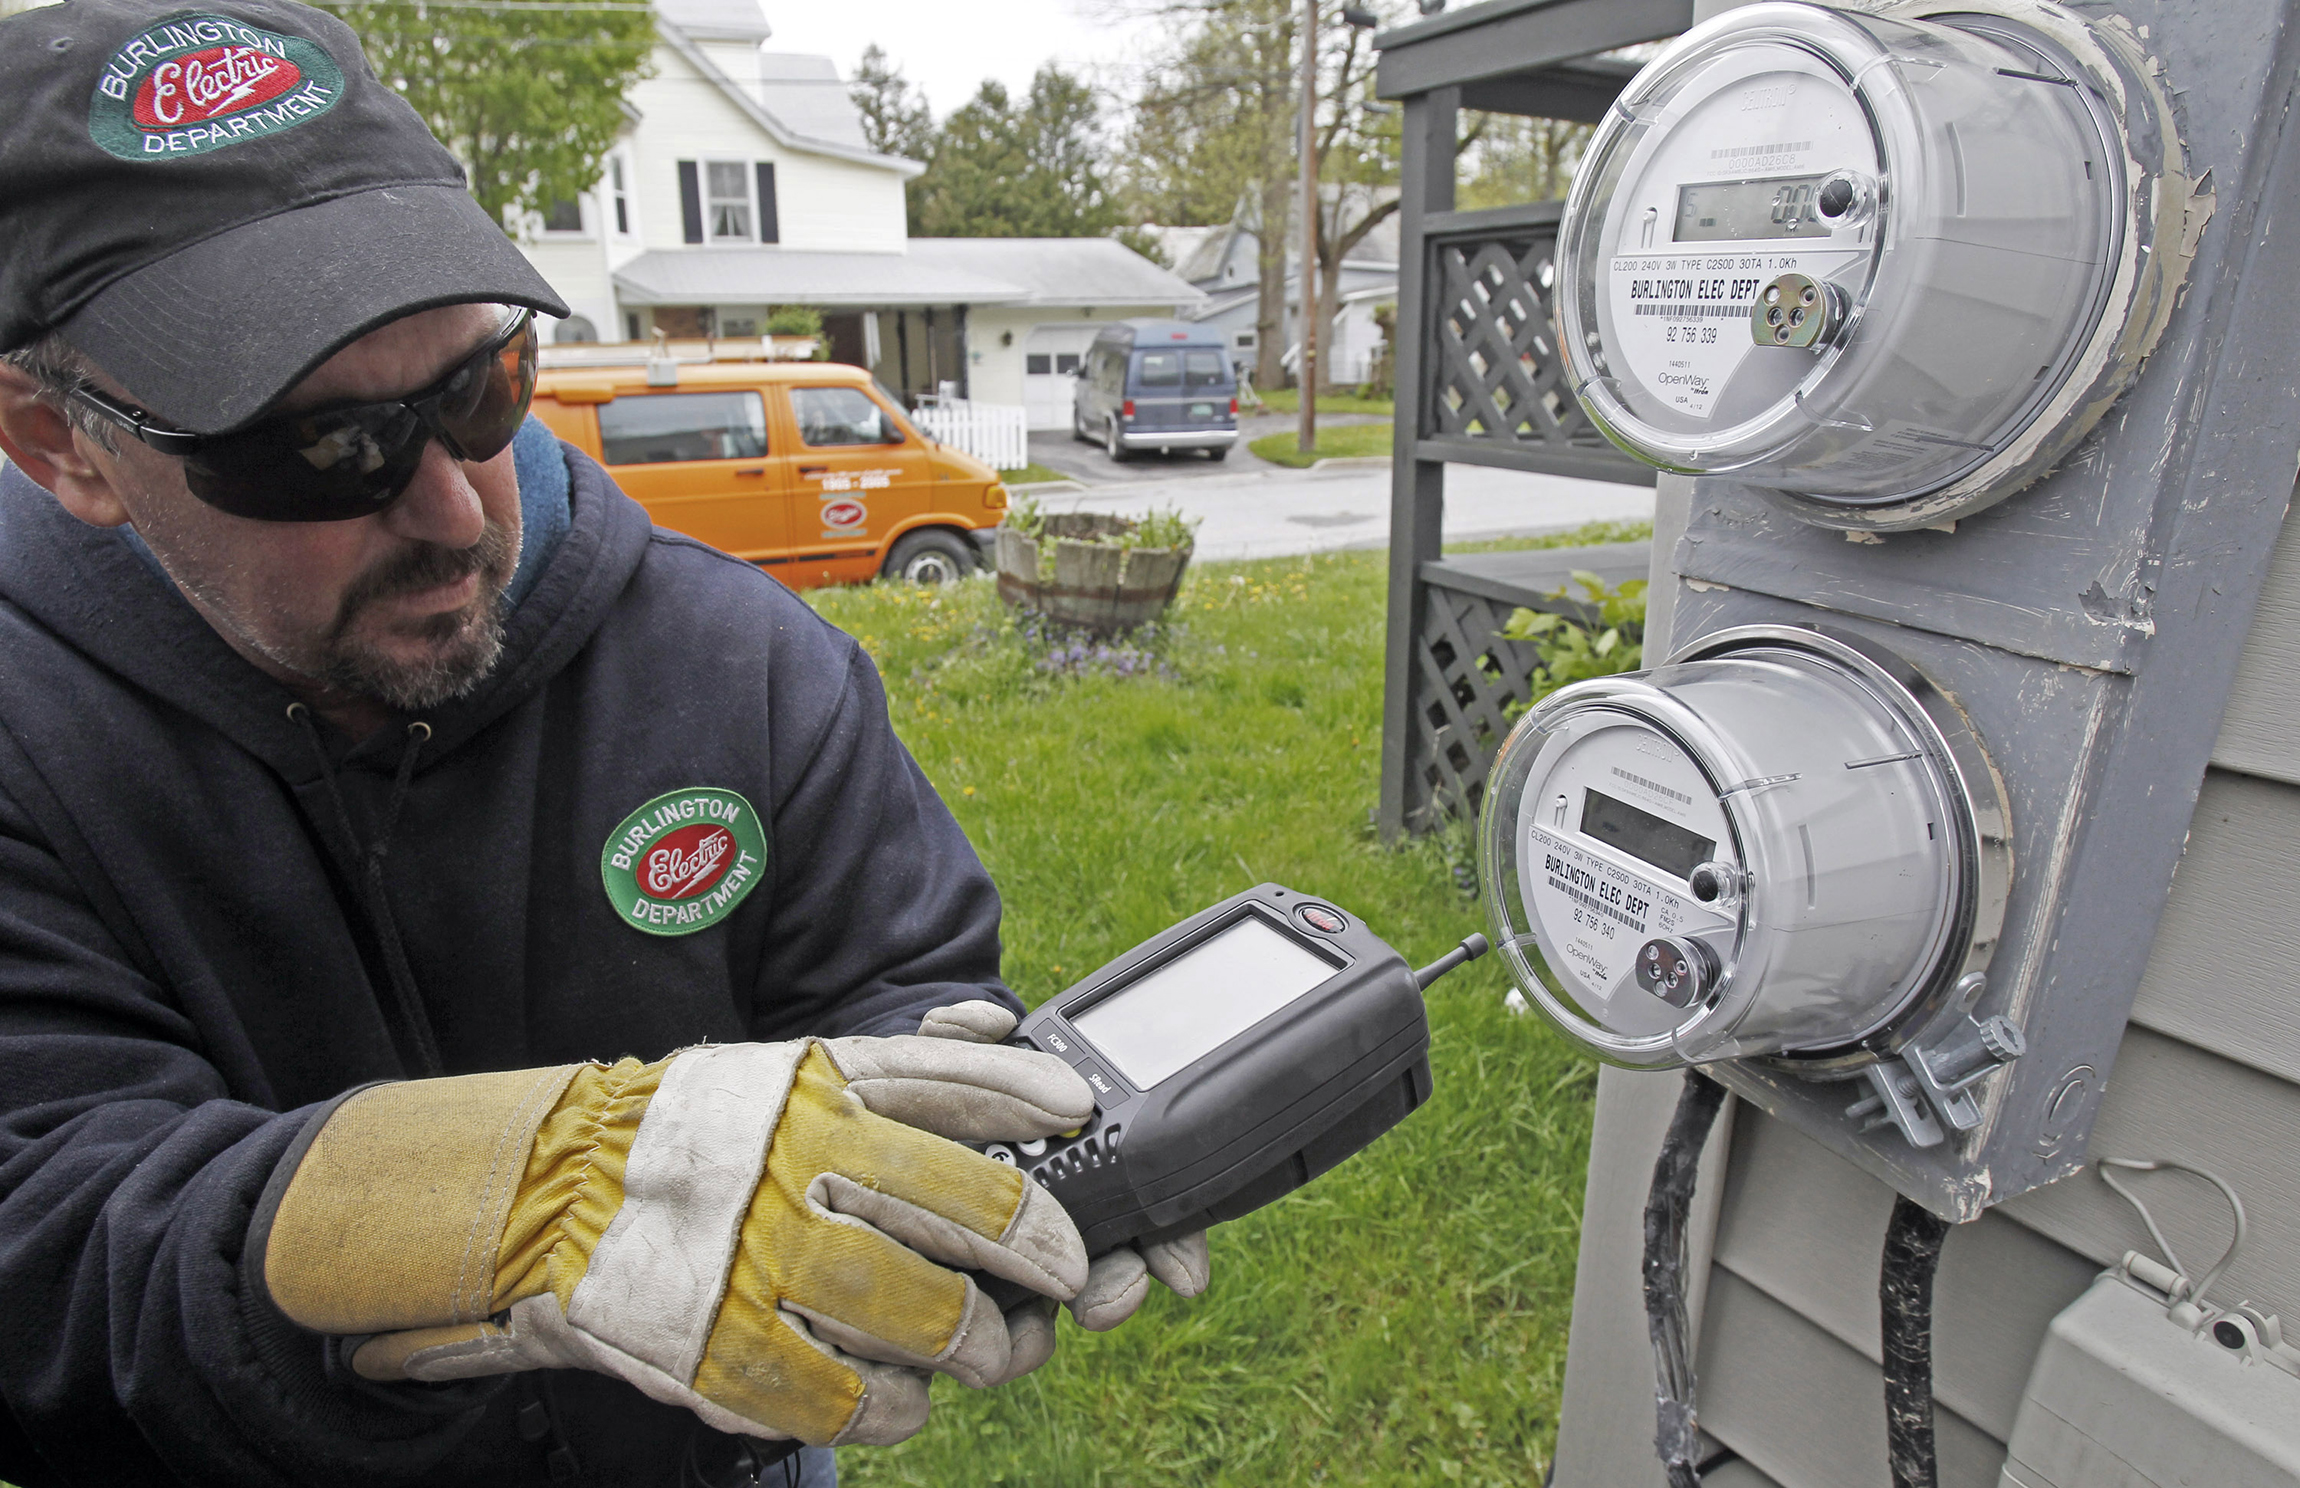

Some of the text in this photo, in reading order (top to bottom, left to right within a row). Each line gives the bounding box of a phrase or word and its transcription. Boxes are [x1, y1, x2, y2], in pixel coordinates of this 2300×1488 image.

[101, 21, 287, 101] BURLINGTON
[153, 47, 280, 123] Electric
[143, 80, 332, 153] DEPARTMENT
[1613, 260, 1638, 272] CL200
[1641, 260, 1662, 271] 240V
[1665, 260, 1677, 270] 3W
[1681, 259, 1702, 270] TYPE
[1739, 258, 1762, 270] 30TA
[1768, 257, 1797, 269] 1.0Kh
[1630, 279, 1761, 300] BURLINGTON ELEC DEPT
[1666, 326, 1718, 344] 92 756 339
[1658, 372, 1708, 389] OpenWay
[1675, 396, 1688, 404] USA
[611, 798, 741, 871] BURLINGTON
[648, 831, 728, 892] Electric
[1531, 830, 1552, 847] CL200
[1554, 841, 1572, 855] 240V
[1586, 856, 1604, 872] TYPE
[1632, 879, 1652, 896] 30TA
[1656, 891, 1680, 909] 1.0Kh
[631, 849, 758, 925] DEPARTMENT
[1545, 853, 1650, 919] BURLINGTON ELEC DEPT
[1573, 908, 1615, 940] 92 756 340
[1660, 907, 1669, 916] CA
[1566, 943, 1607, 973] OpenWay
[1046, 1033, 1068, 1053] FC300
[1088, 1073, 1112, 1094] SRead
